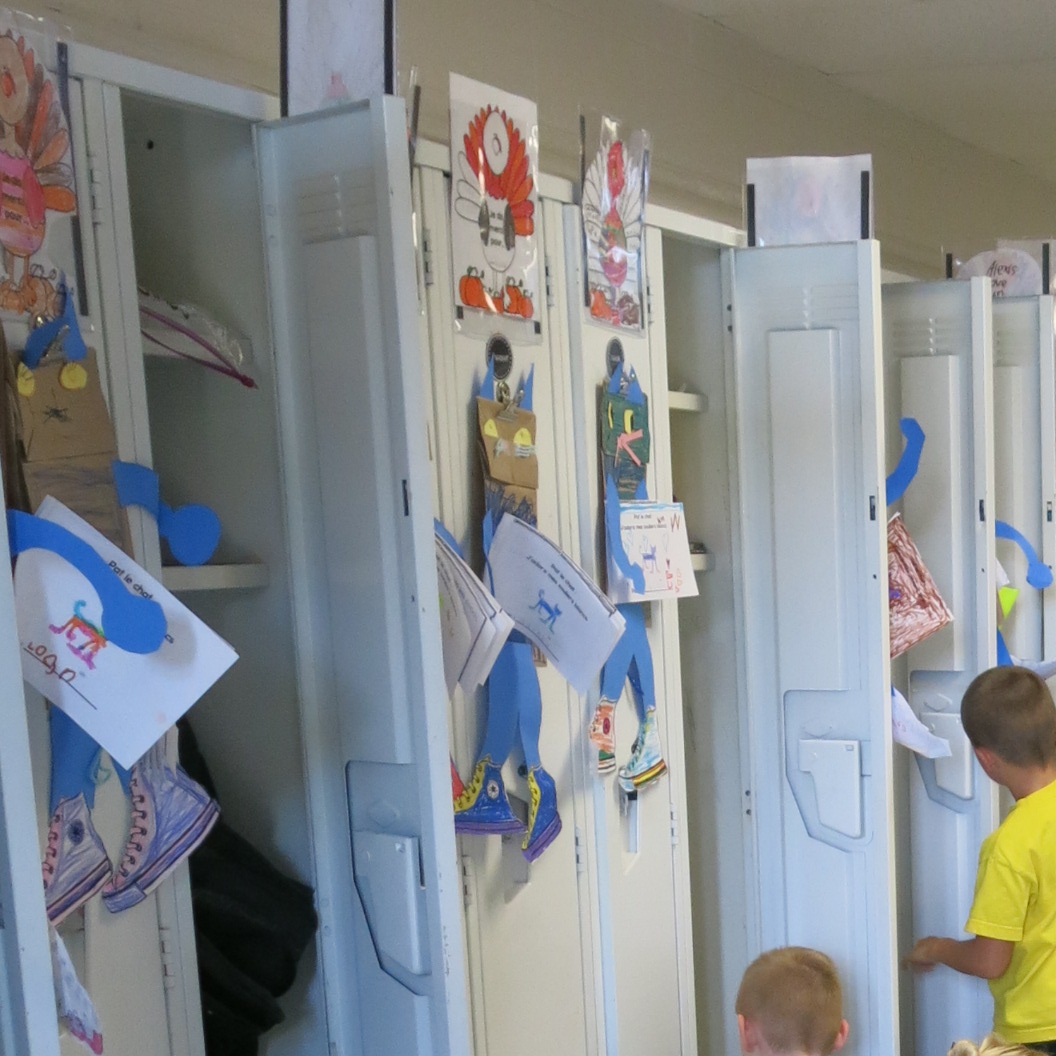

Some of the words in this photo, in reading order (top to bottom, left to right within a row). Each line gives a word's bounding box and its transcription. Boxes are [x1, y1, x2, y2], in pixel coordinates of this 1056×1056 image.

[108, 560, 126, 578] Pat
[124, 573, 133, 585] le
[132, 582, 154, 601] chat
